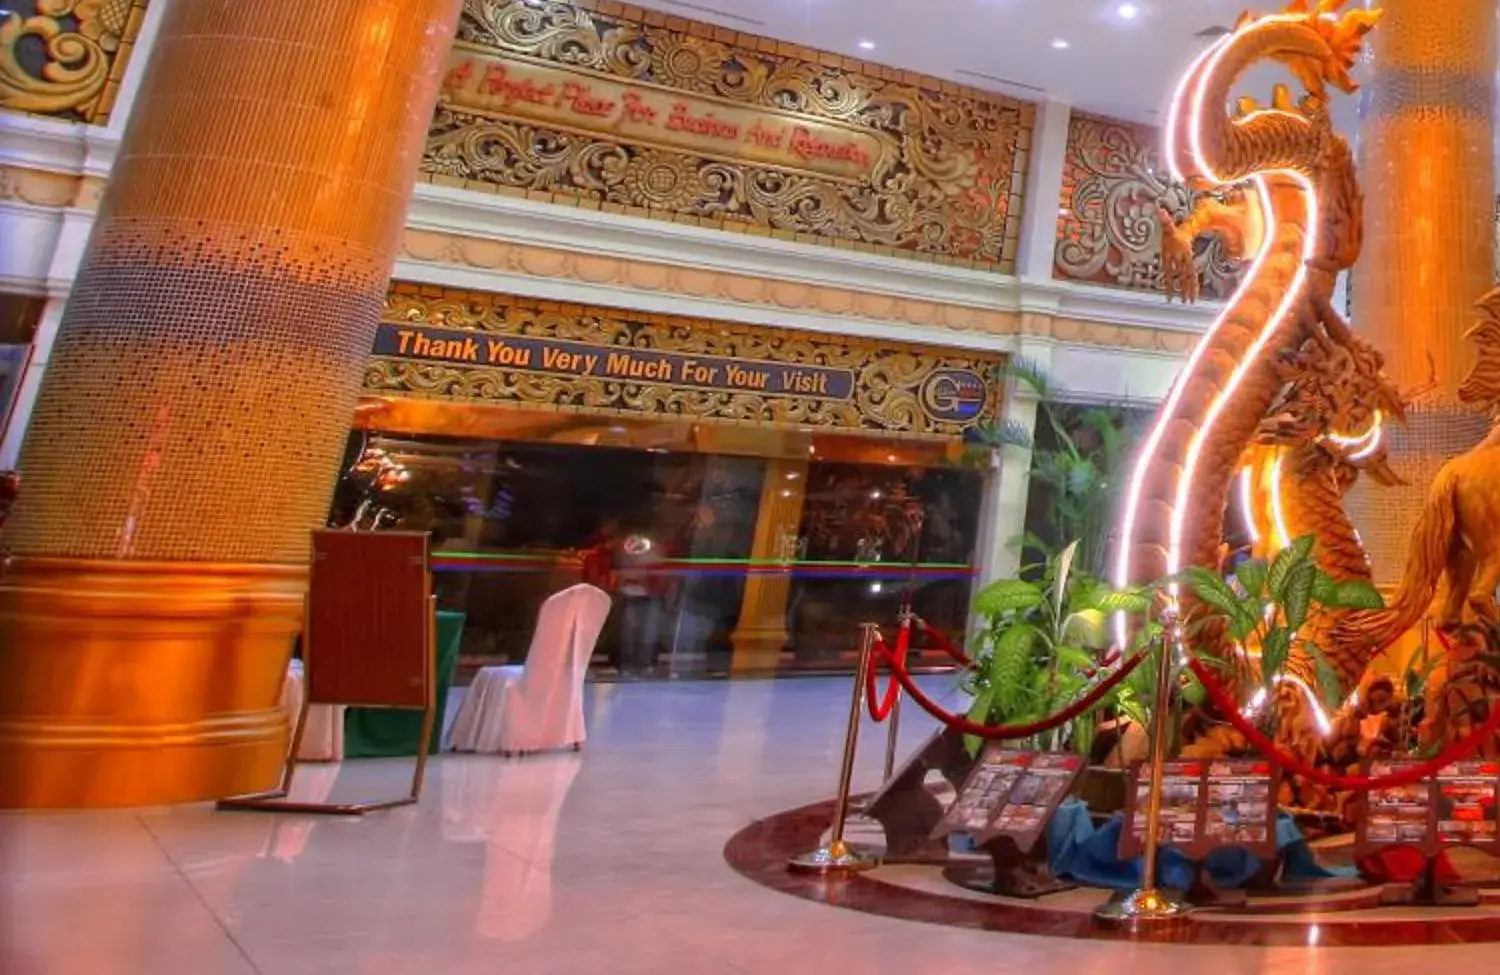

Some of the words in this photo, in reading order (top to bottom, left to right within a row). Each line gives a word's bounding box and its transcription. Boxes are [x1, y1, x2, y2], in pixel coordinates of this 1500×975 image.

[553, 81, 615, 117] Place
[743, 119, 784, 150] And
[397, 331, 479, 361] Thank
[486, 340, 531, 367] You
[543, 346, 599, 375] Very
[606, 353, 672, 379] Much
[681, 360, 719, 384] For
[725, 364, 770, 389] Your
[783, 370, 830, 394] Visit
